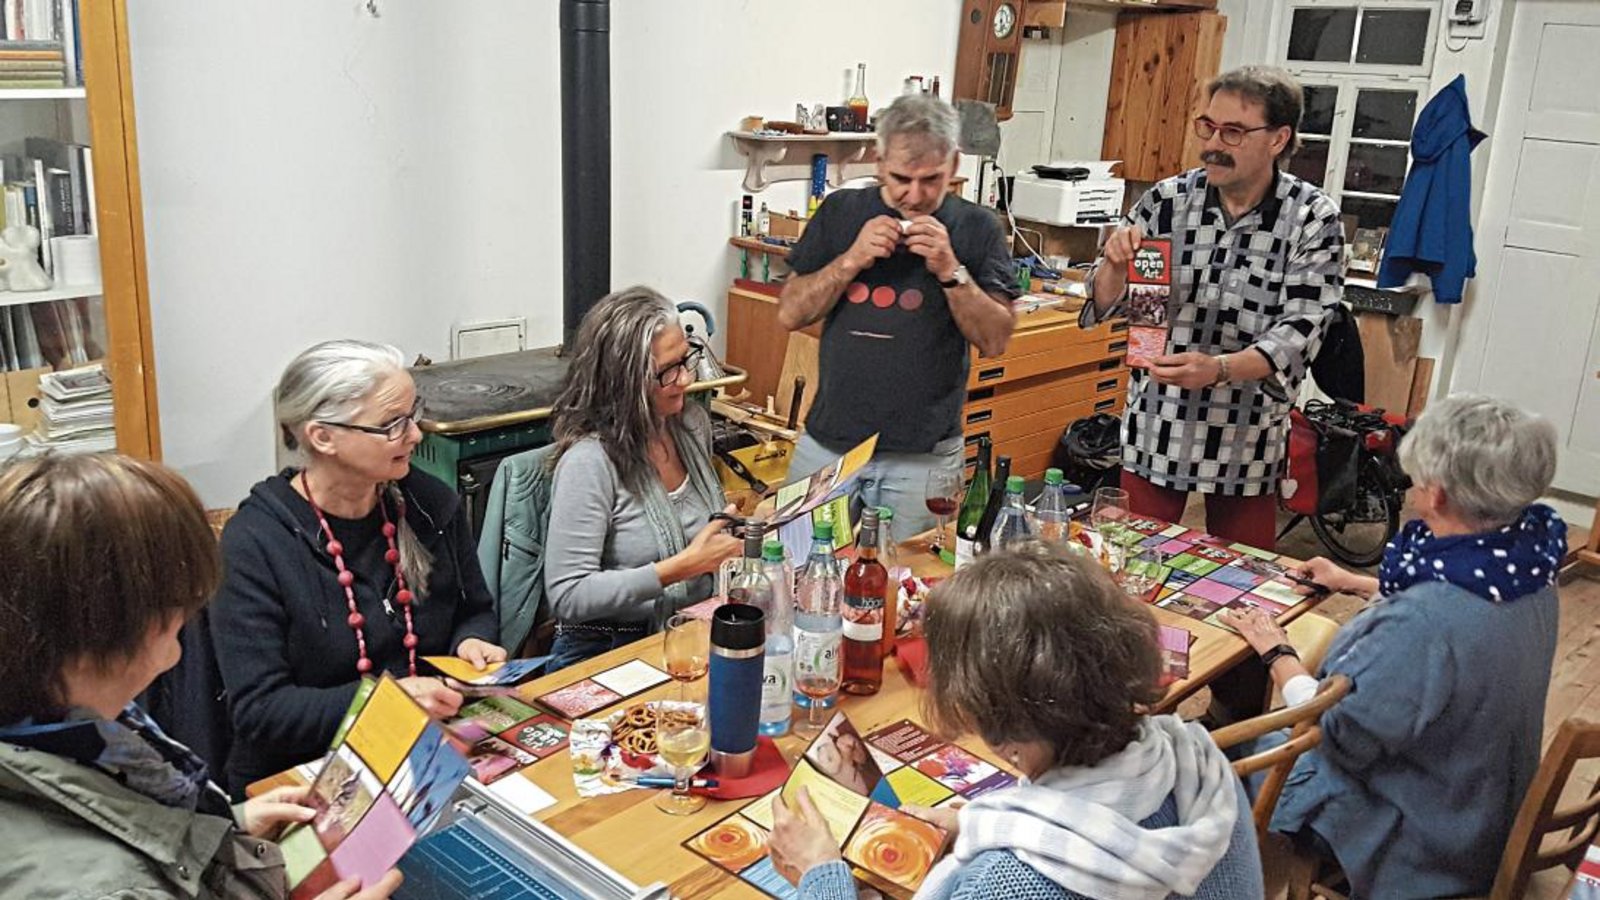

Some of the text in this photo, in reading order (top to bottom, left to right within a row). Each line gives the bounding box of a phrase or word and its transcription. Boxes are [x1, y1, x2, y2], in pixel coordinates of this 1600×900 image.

[1134, 259, 1164, 271] open
[1143, 268, 1163, 279] Art.
[523, 726, 560, 746] open
